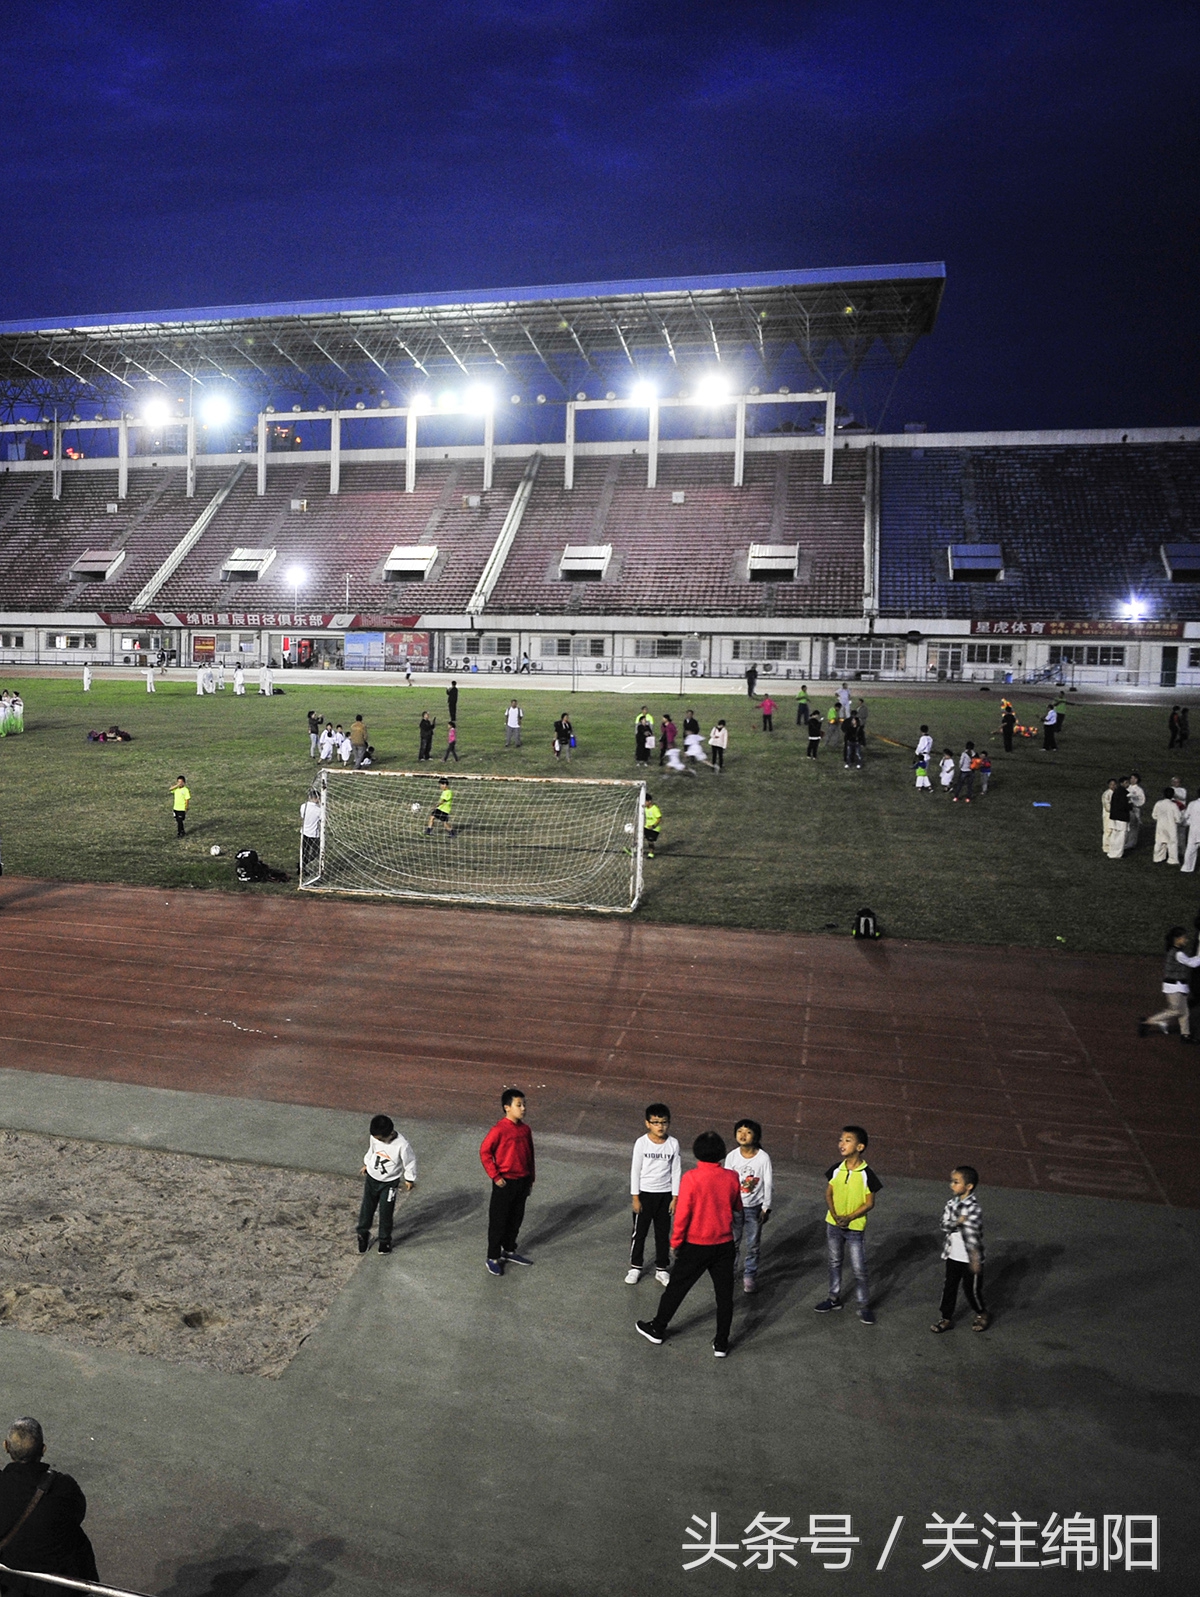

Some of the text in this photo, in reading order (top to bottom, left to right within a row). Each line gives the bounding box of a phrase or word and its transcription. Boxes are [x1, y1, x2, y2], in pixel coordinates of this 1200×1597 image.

[186, 613, 323, 627] 绵阳星辰田径俱乐部
[975, 621, 1046, 634] 星虎体育
[374, 1155, 390, 1175] K
